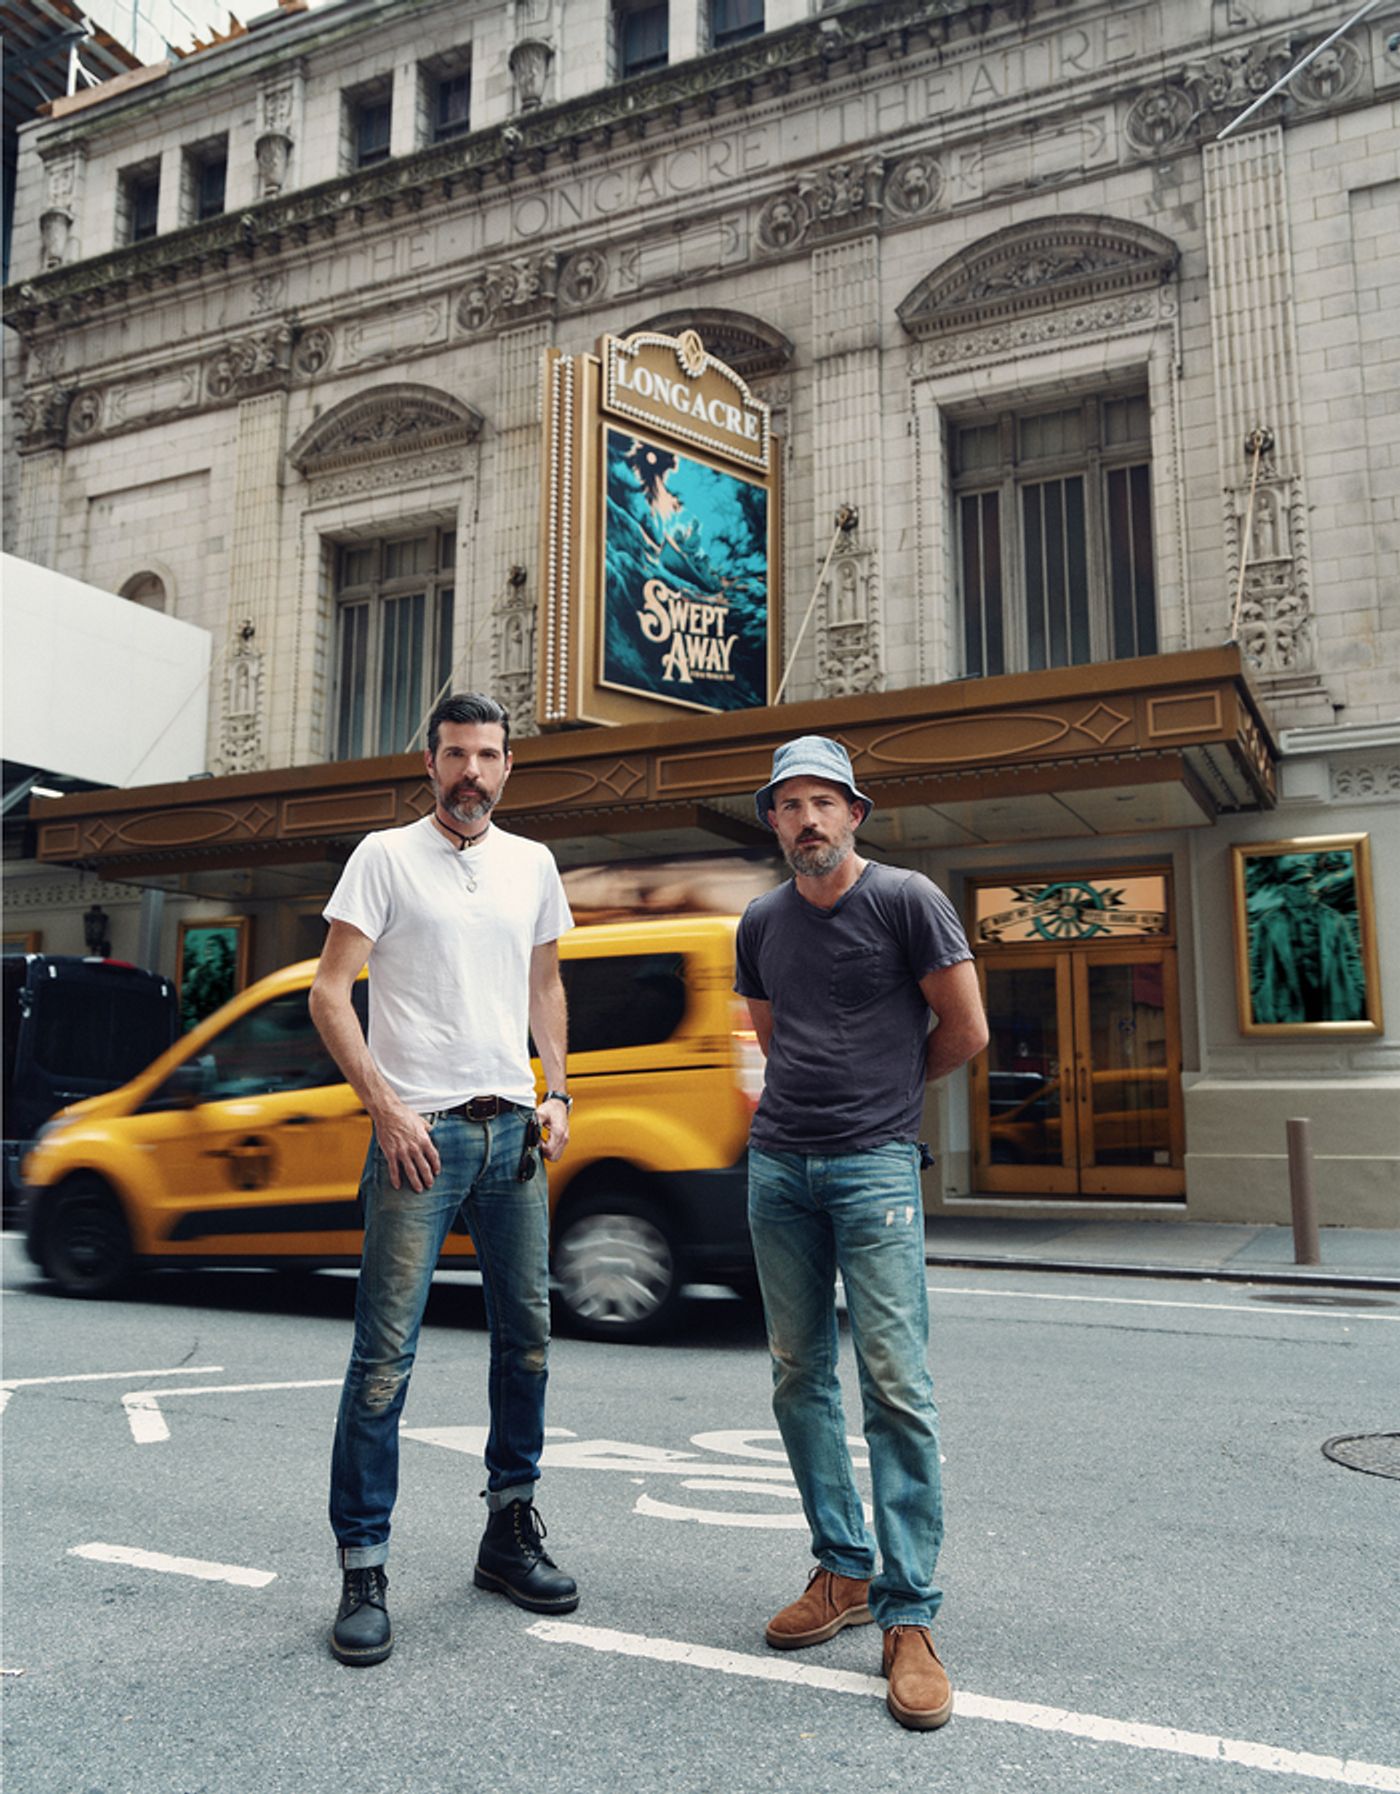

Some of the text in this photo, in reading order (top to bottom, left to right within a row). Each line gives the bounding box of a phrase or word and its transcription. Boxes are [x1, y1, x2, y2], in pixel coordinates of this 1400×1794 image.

[331, 12, 1136, 291] THE LONGACRE THEATRE
[617, 358, 760, 441] LONGACRE
[636, 579, 729, 643] SWEPT
[662, 631, 739, 683] AWAY
